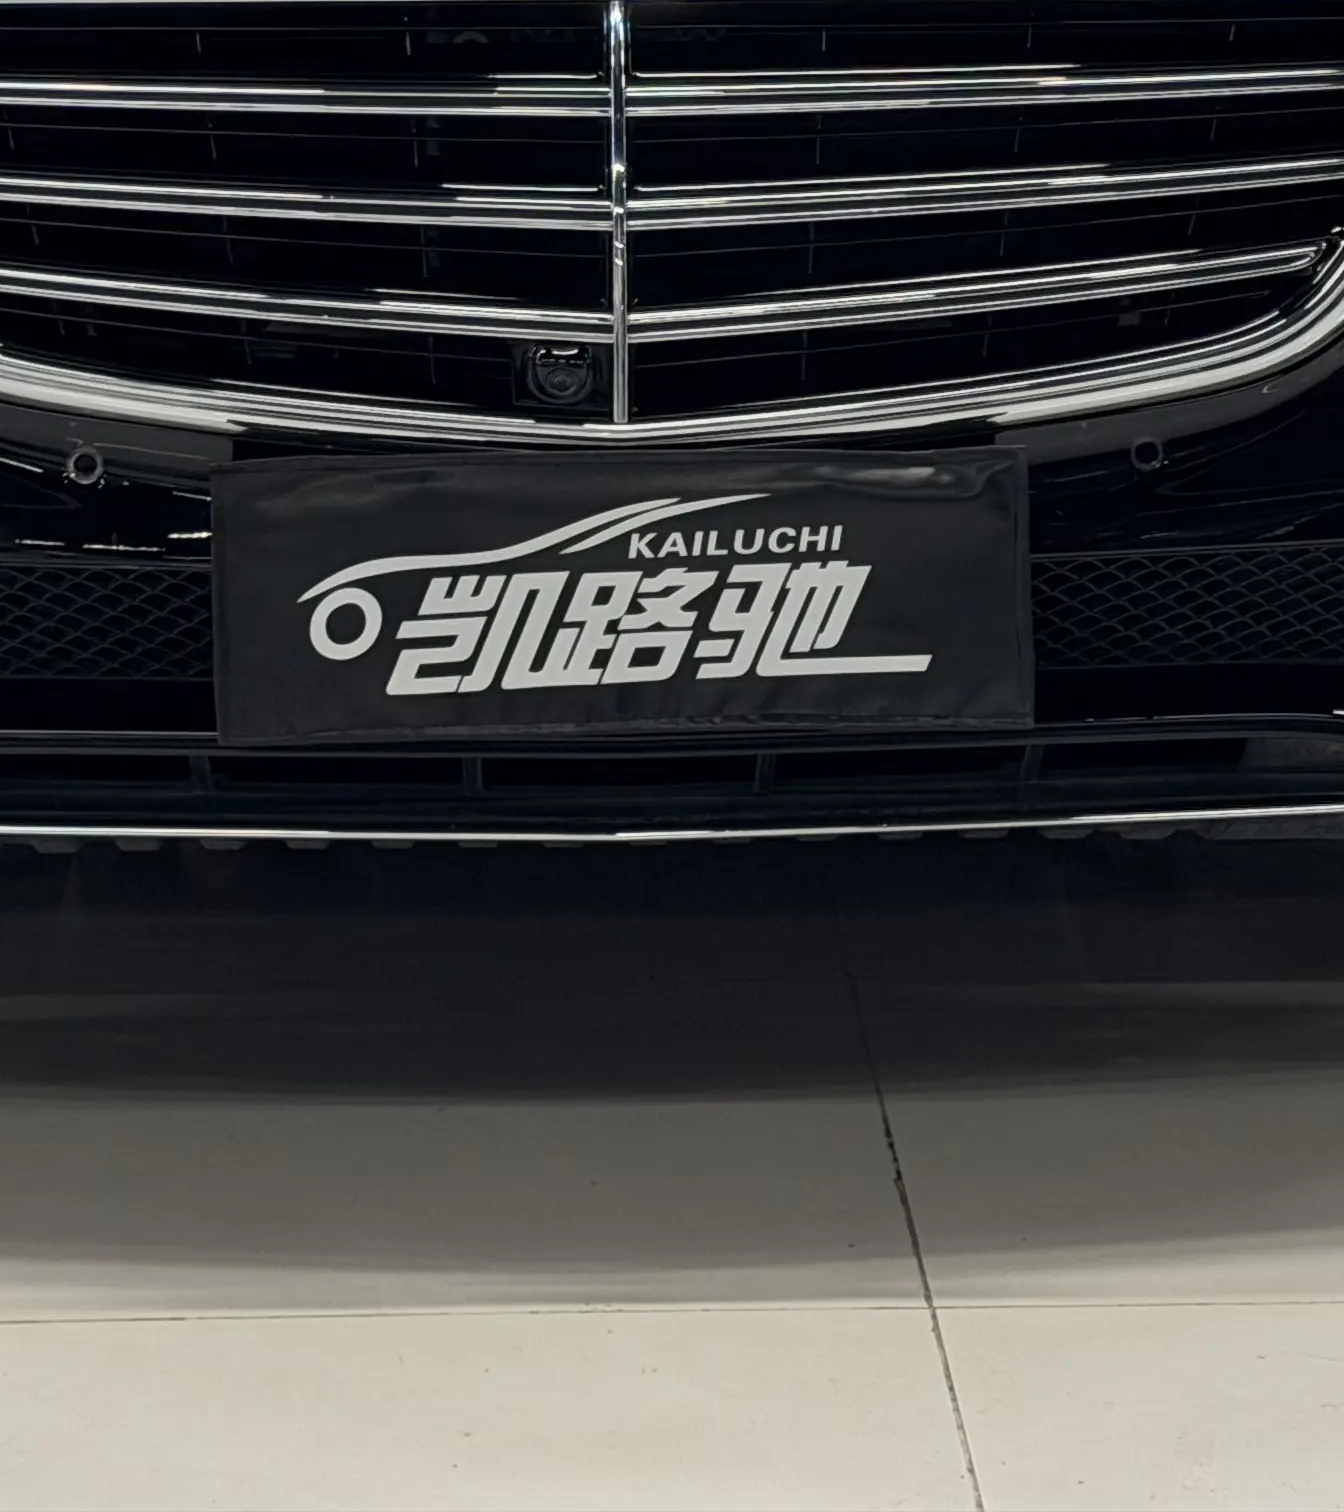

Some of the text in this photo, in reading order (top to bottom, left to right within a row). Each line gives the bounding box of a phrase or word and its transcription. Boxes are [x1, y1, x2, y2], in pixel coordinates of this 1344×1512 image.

[628, 524, 843, 559] KAILUCHI
[386, 560, 932, 695] 凯路驰
